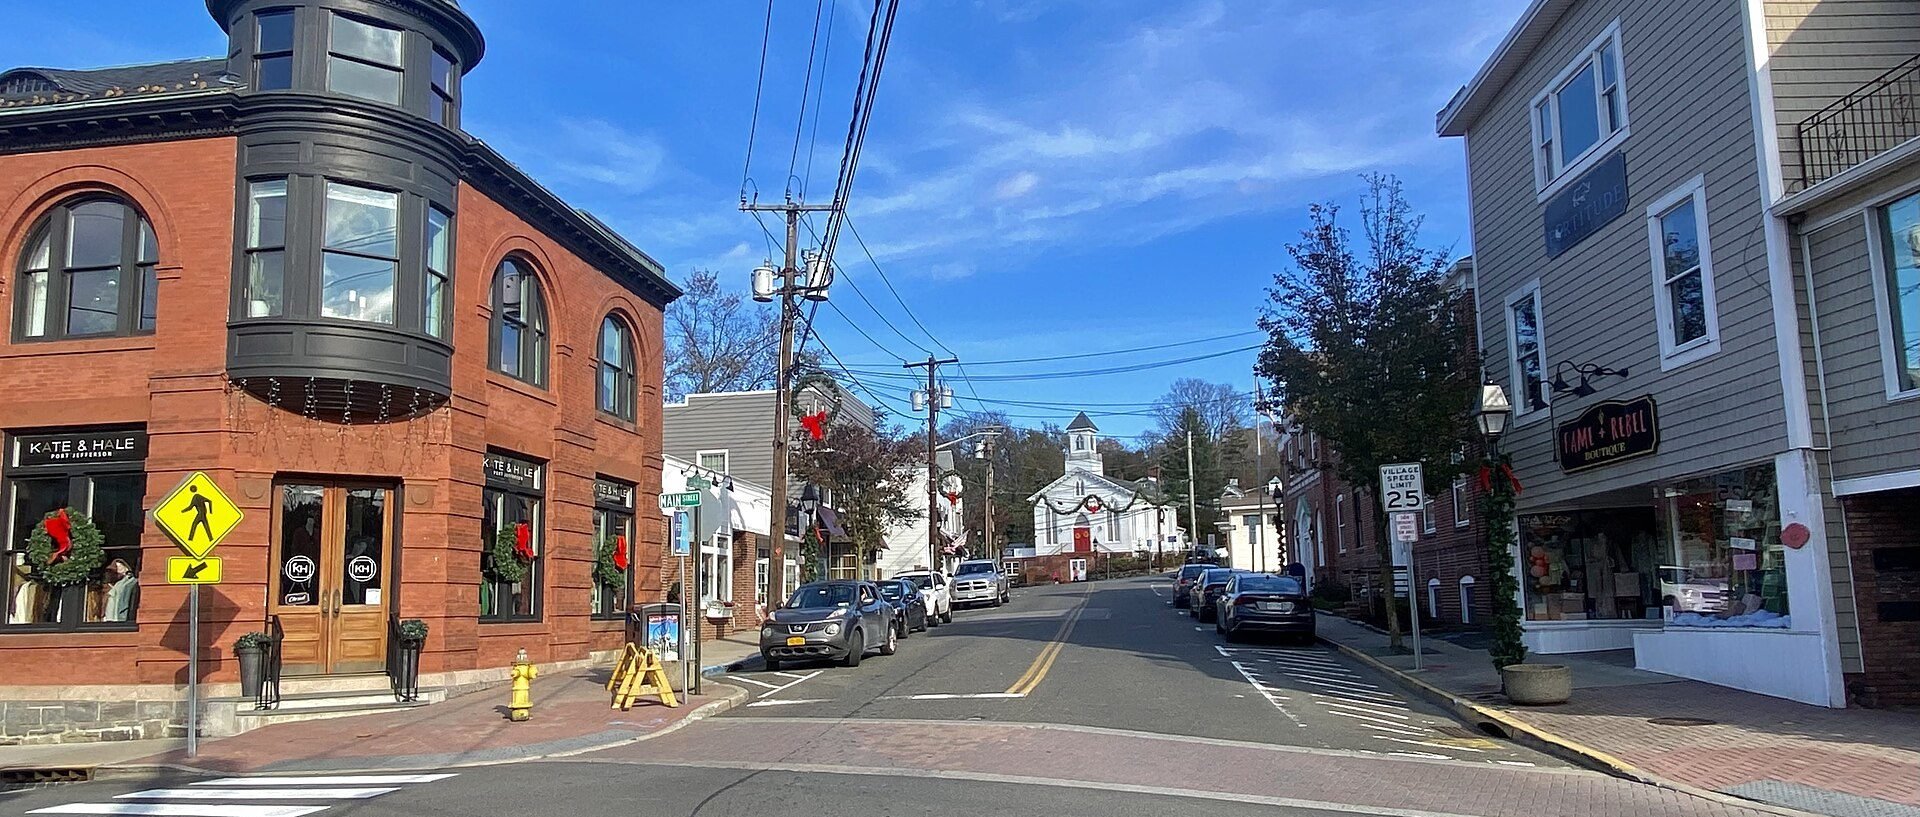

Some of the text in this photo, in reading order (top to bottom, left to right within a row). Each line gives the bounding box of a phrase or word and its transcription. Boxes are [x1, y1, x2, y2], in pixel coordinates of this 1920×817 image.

[1548, 185, 1622, 243] FORTITUDE
[1564, 427, 1594, 454] FAME
[1611, 410, 1647, 441] REBEL
[30, 438, 134, 453] KATE & HALE
[1585, 443, 1626, 460] BOUTIQUE
[483, 459, 504, 471] KTE
[514, 465, 533, 478] HLE
[1383, 467, 1419, 475] VILLAGE
[613, 488, 627, 497] HLE
[1387, 490, 1420, 508] 25
[661, 494, 681, 507] MAIN
[292, 563, 308, 573] KH
[355, 565, 369, 573] KH
